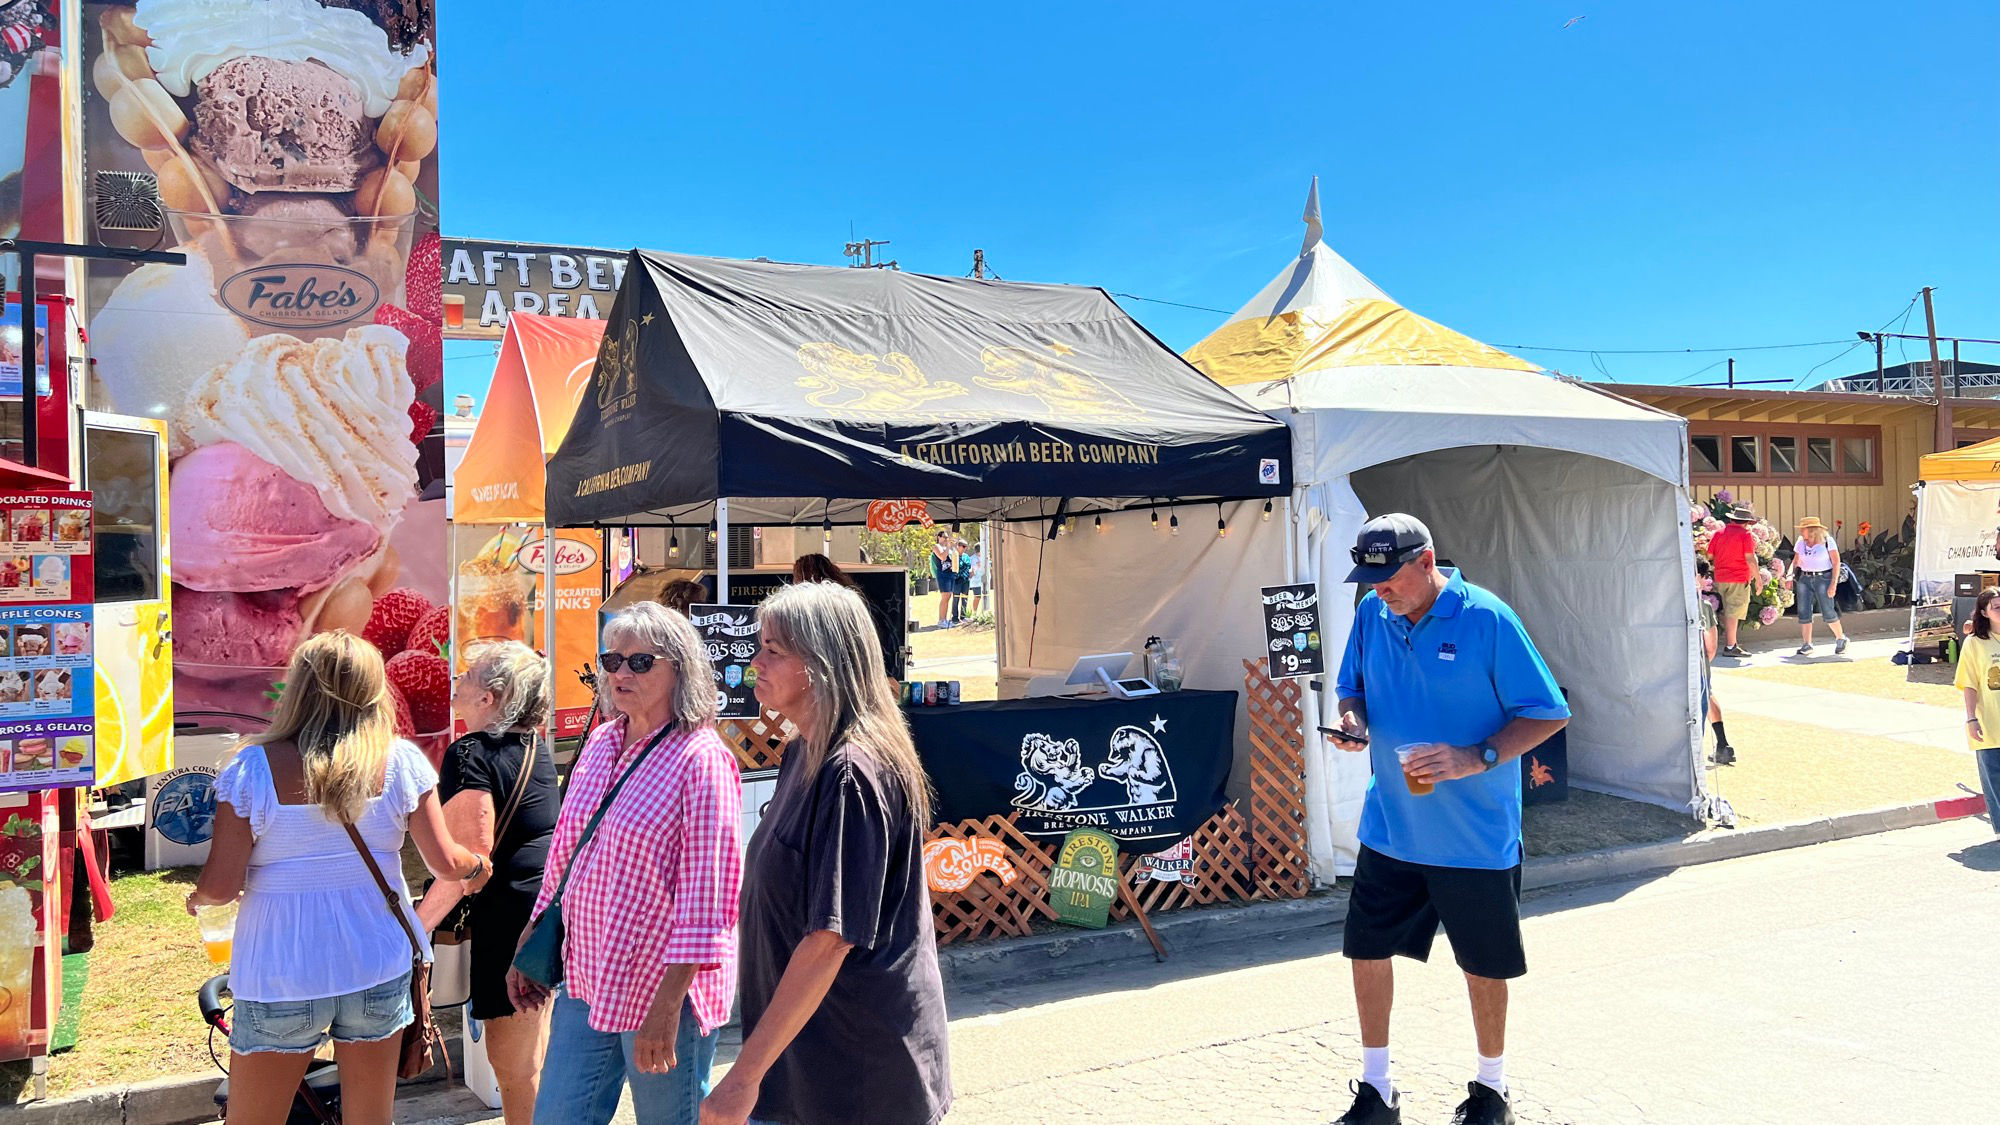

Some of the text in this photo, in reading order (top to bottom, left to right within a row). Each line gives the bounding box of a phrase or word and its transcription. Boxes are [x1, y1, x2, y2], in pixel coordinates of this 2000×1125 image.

[441, 249, 536, 286] AFT
[248, 275, 362, 310] Fabe's
[900, 442, 1158, 464] A CALIFORNIA BEER COMPANY
[621, 460, 651, 486] COMPANY
[51, 496, 92, 508] DRINKS
[883, 499, 908, 521] CALI
[891, 507, 934, 528] SQUEEZE
[530, 544, 588, 564] Fbe's
[1947, 547, 1983, 559] CHANGING
[535, 598, 591, 611] DINKS
[1269, 592, 1287, 603] BEER
[1295, 598, 1314, 608] MENU
[0, 609, 82, 619] FFLE CONES
[699, 614, 724, 625] BEER
[1271, 613, 1314, 630] 805 805
[734, 623, 758, 635] MENU
[730, 643, 755, 656] 805
[1281, 654, 1299, 671] $9
[34, 723, 44, 732] &
[47, 723, 93, 732] GELATO
[152, 765, 217, 790] VENTURA COUN
[1115, 805, 1175, 823] WALKER
[940, 837, 978, 874] CALI
[1062, 836, 1113, 874] FIRESTONE
[1144, 856, 1190, 871] WALKER
[953, 853, 1016, 884] SQUEEZE
[1051, 867, 1117, 898] HOPNOSIS
